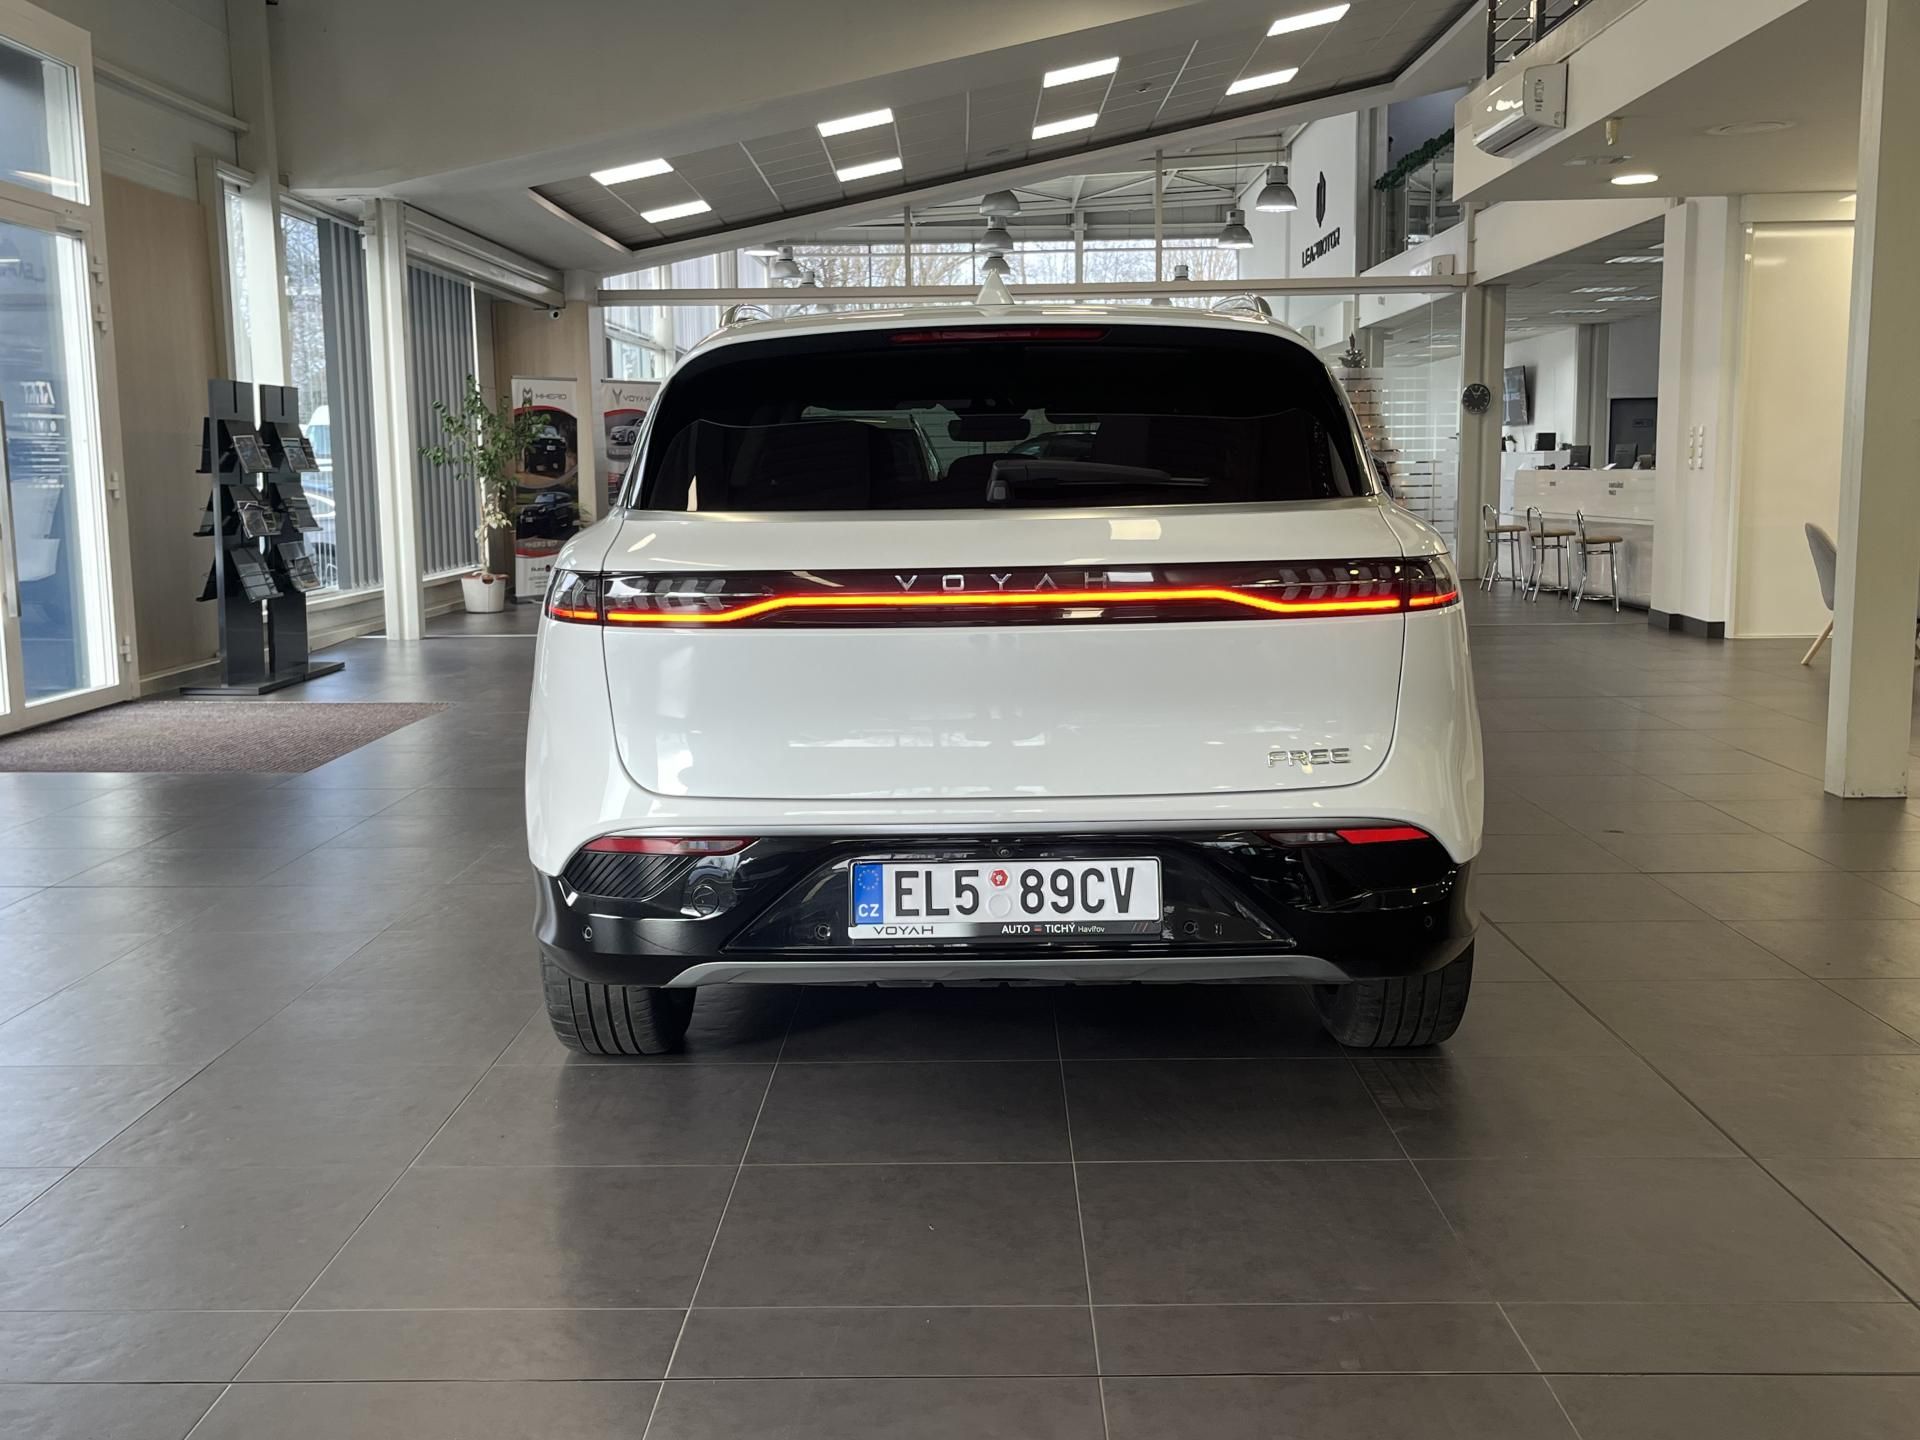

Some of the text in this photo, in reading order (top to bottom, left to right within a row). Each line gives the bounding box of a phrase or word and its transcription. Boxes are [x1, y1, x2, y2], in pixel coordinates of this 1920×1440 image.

[894, 571, 1108, 591] VOYAH
[1267, 748, 1350, 767] FREE
[895, 866, 1135, 917] EL5 89CV
[858, 904, 880, 917] CZ
[873, 926, 934, 935] VOYAH
[1001, 924, 1031, 934] AUTO
[1044, 921, 1075, 934] TICHÝ
